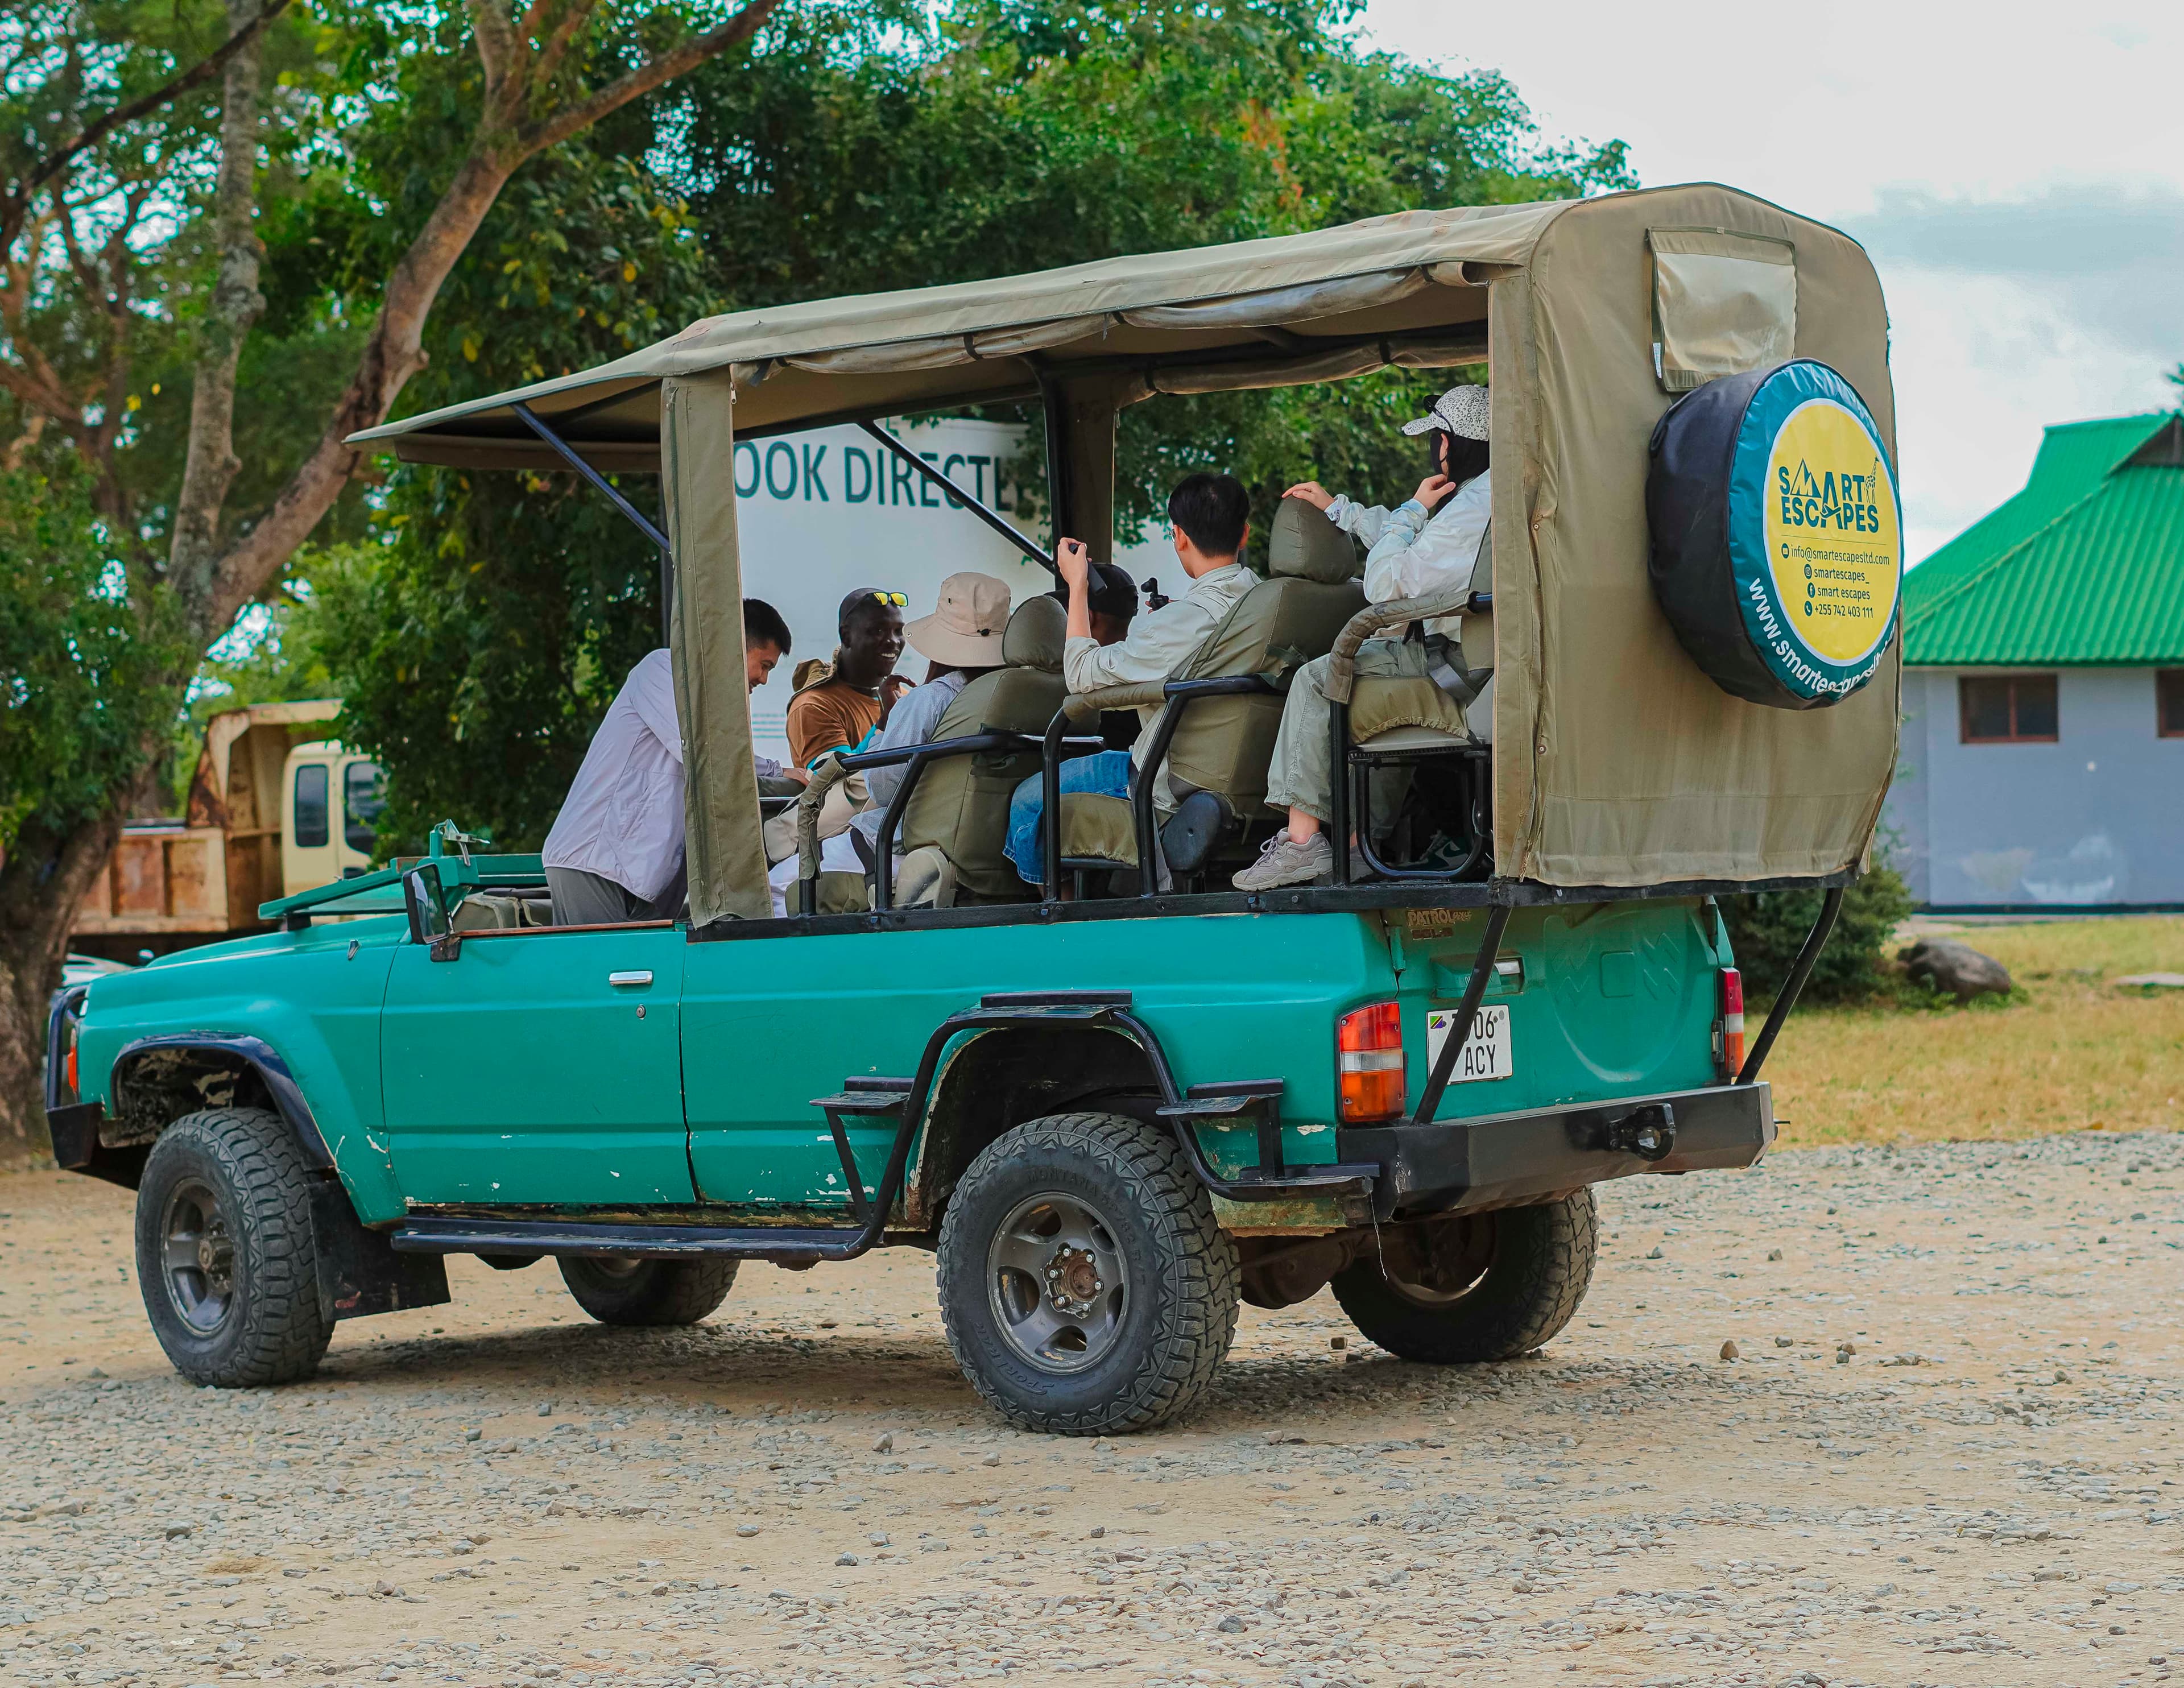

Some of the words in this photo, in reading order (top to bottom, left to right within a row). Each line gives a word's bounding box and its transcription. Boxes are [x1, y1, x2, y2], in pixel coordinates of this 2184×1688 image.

[1778, 457, 1865, 508] SMART
[1781, 496, 1879, 533] ESCAPES
[1791, 544, 1889, 565] info@smartescapesltd.com
[1814, 568, 1869, 584] smartescapes_
[1818, 586, 1839, 598] smart
[1841, 589, 1870, 602] escapes
[1815, 604, 1831, 615] +255
[1834, 605, 1845, 616] 742
[1848, 606, 1860, 617] 403
[1862, 607, 1873, 618] 111
[1408, 909, 1455, 926] PATROL
[1452, 1011, 1495, 1041] 06
[1465, 1044, 1496, 1075] ACY
